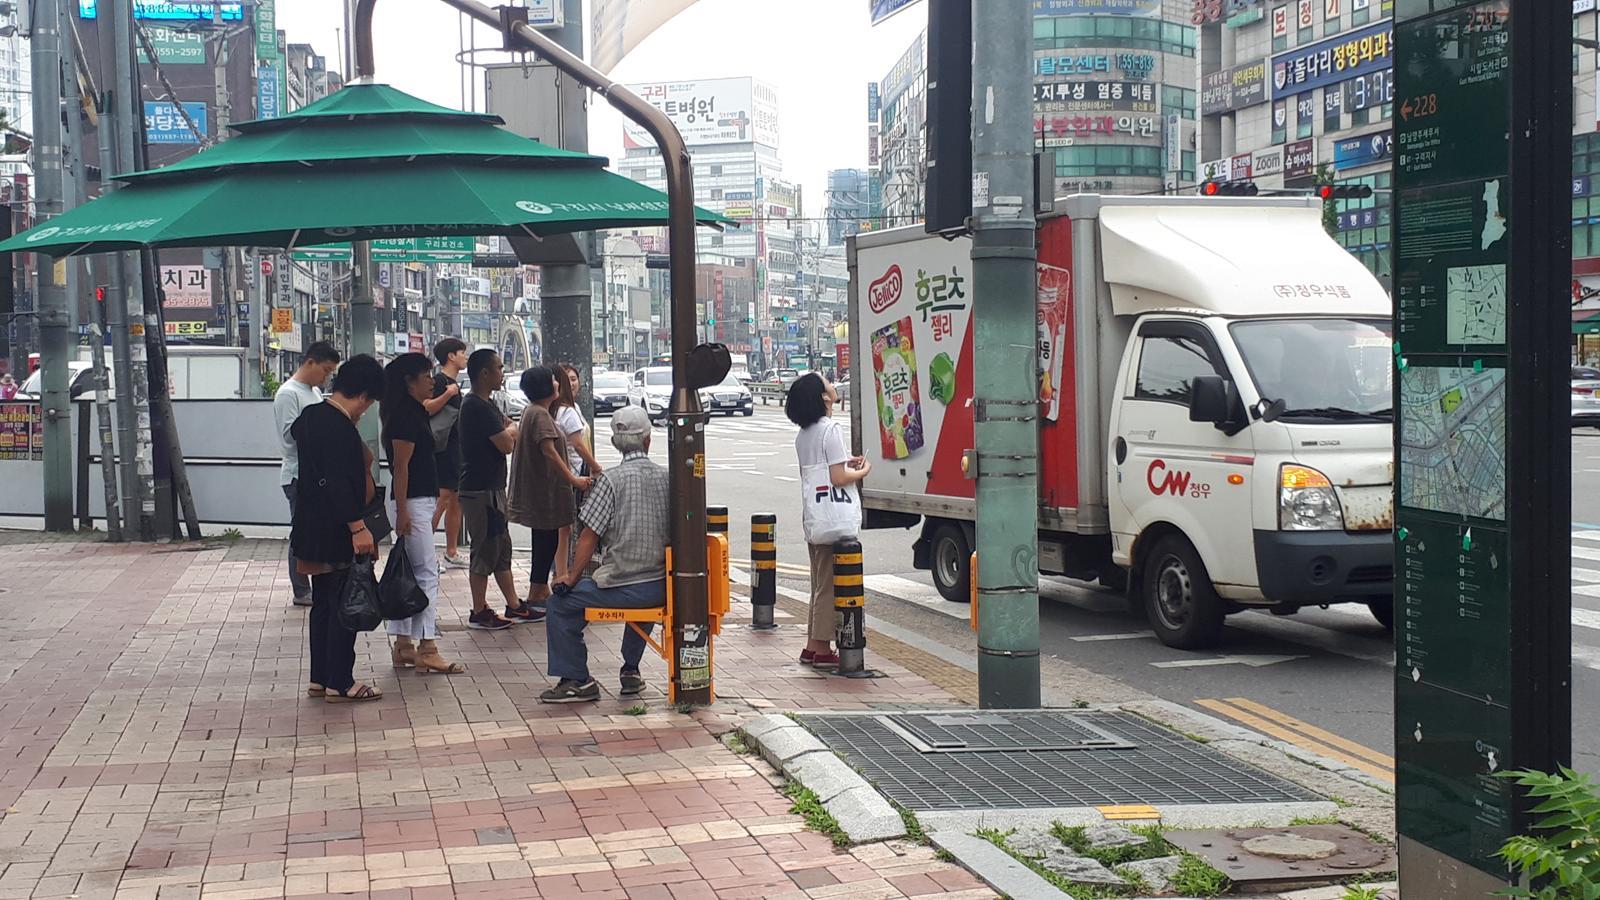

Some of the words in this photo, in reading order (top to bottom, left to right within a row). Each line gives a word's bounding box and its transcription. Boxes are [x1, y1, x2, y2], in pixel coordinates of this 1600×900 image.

[1275, 10, 1285, 33] 보
[1301, 0, 1311, 24] 정
[1040, 56, 1111, 75] 탈모센터
[1470, 58, 1500, 74] 시립도서관
[641, 85, 667, 100] 구리
[1041, 83, 1085, 99] 지루성
[1097, 82, 1123, 99] 염증
[1131, 84, 1152, 100] 비듬
[1299, 98, 1312, 117] 야간
[1326, 92, 1340, 111] 진료
[1413, 93, 1437, 117] 228
[1118, 116, 1154, 137] 의원
[1256, 156, 1280, 171] Zoom
[424, 240, 464, 248] 구리보건소
[164, 269, 208, 290] 치과
[380, 270, 389, 285] CU
[914, 265, 966, 323] 후르츠
[1273, 284, 1352, 299] (주)청우식품
[931, 312, 953, 342] 젤리
[815, 485, 852, 503] FILA
[1190, 482, 1211, 499] 청우
